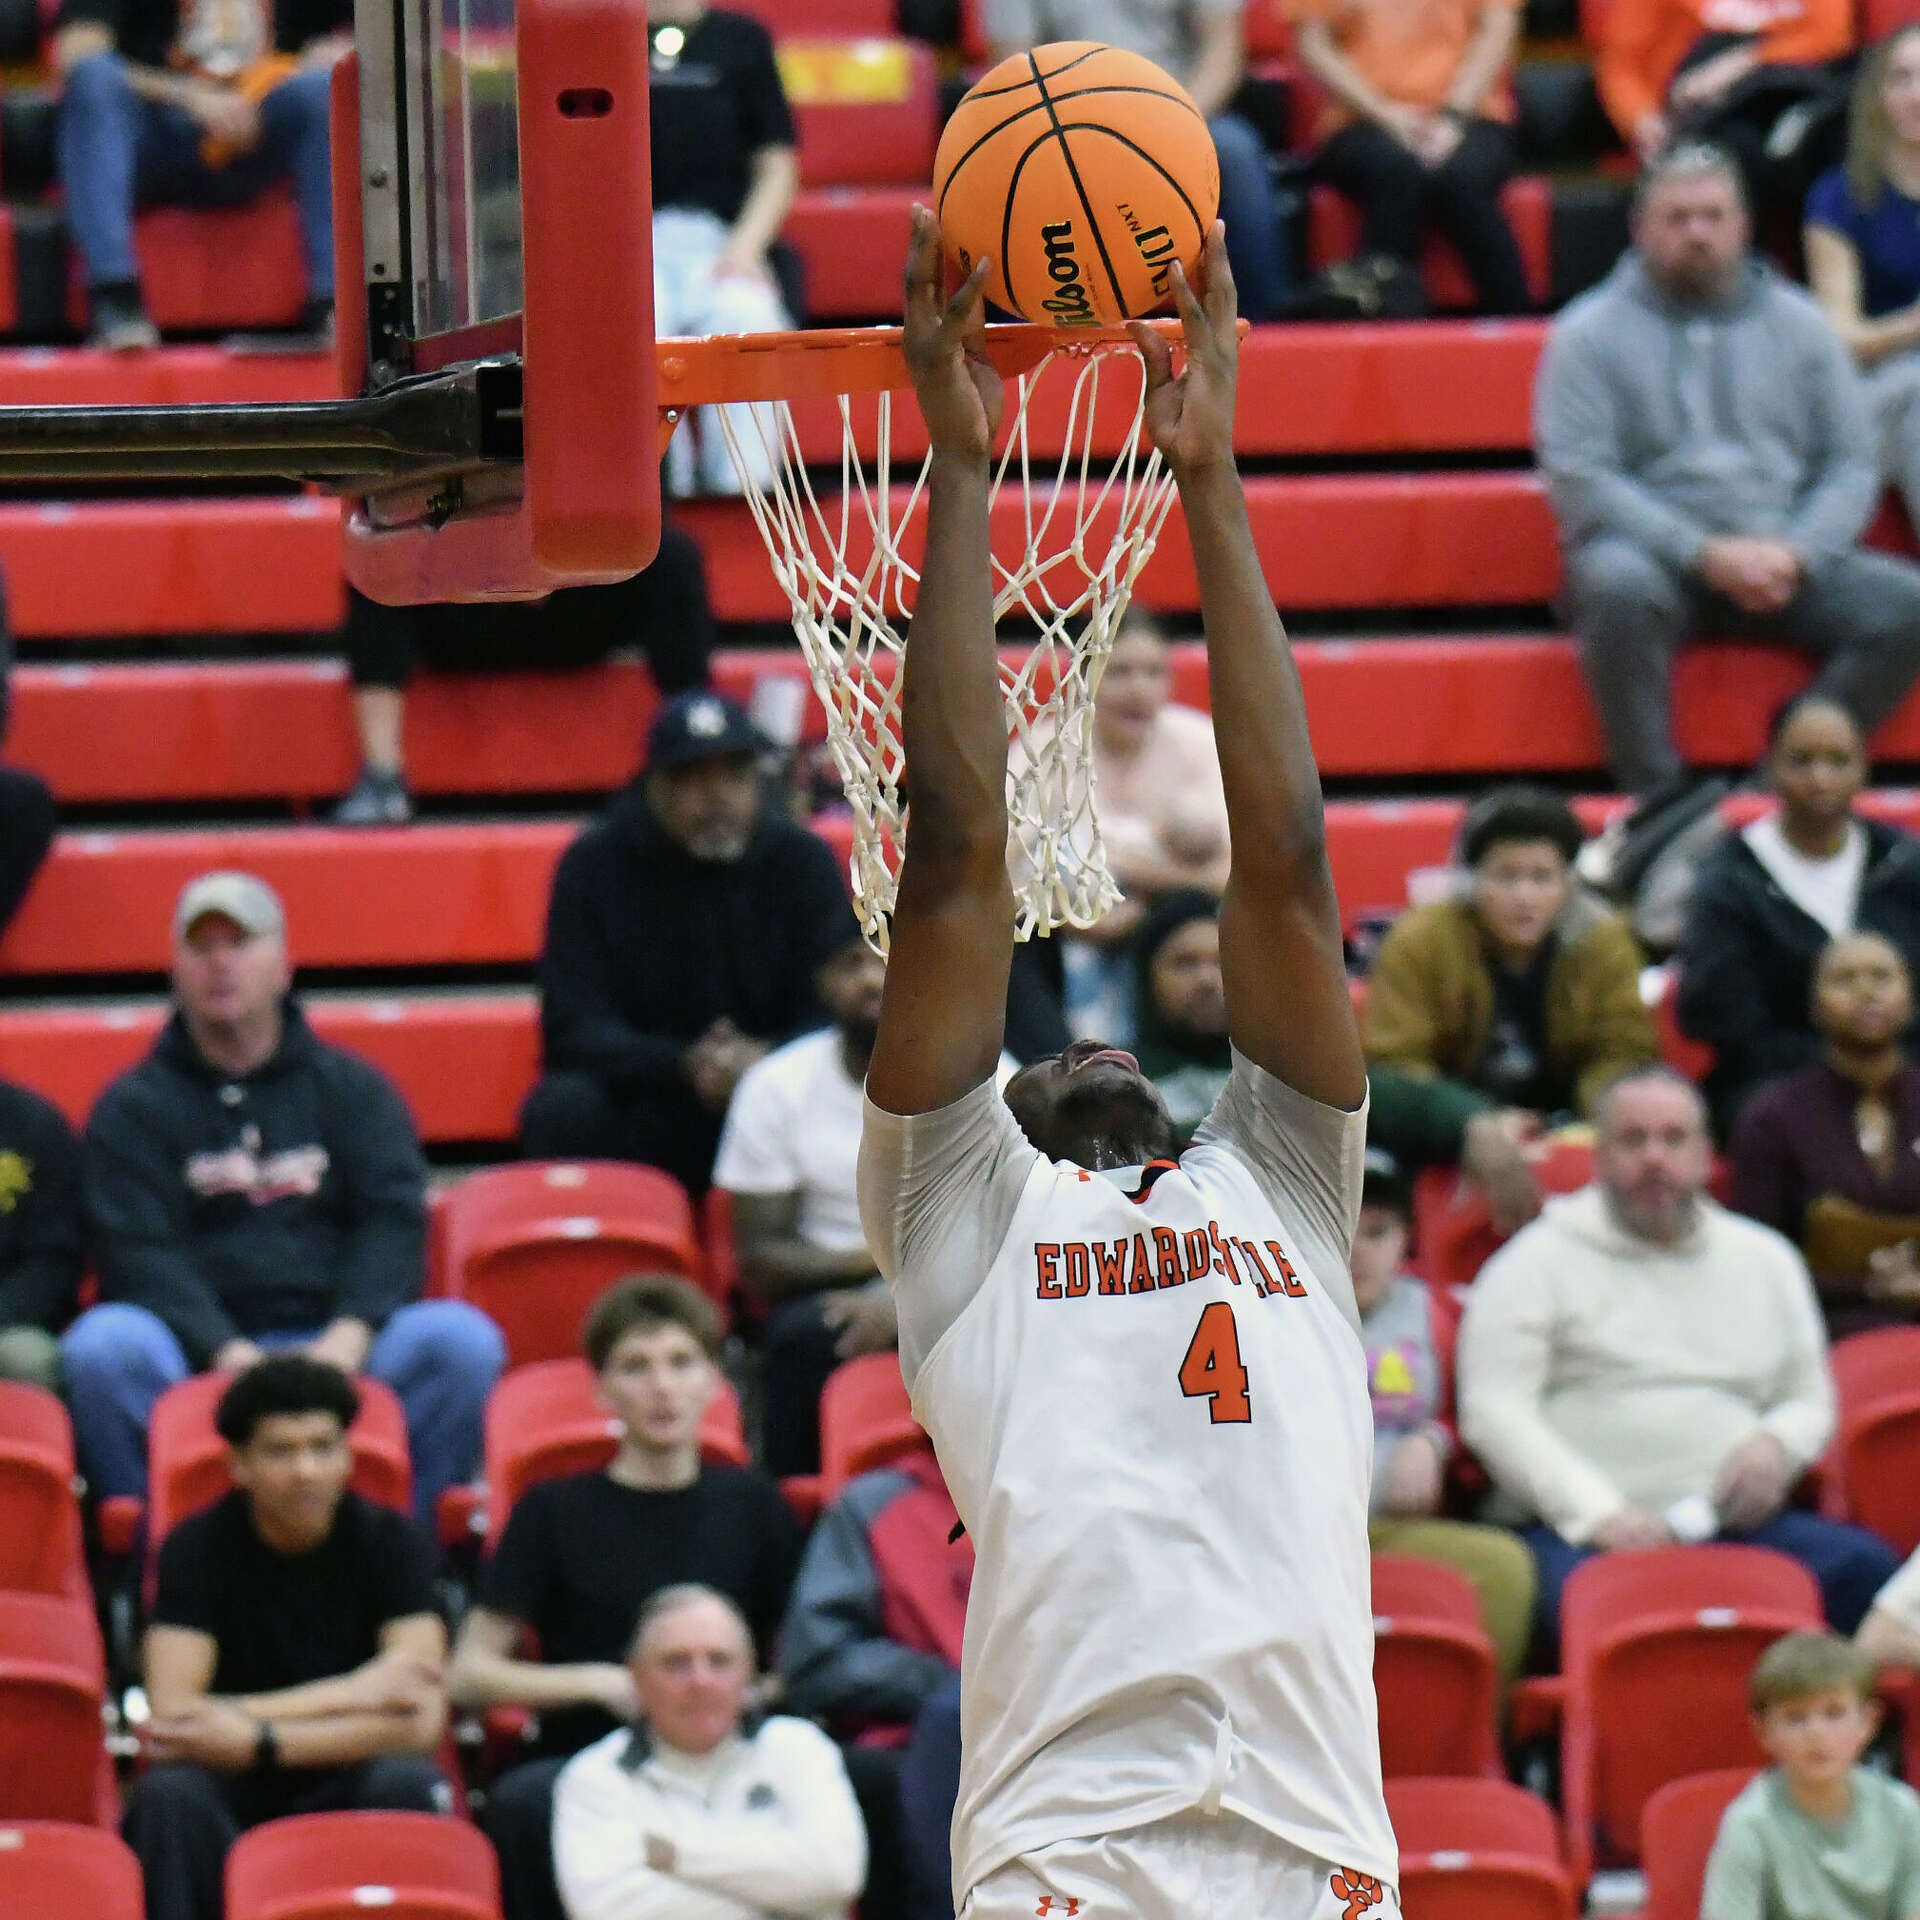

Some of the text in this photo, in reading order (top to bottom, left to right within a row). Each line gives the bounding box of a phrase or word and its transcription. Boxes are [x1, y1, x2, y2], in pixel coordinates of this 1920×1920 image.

[1117, 203, 1142, 232] NXT
[1041, 220, 1101, 327] ilson
[1178, 1301, 1251, 1424] 4
